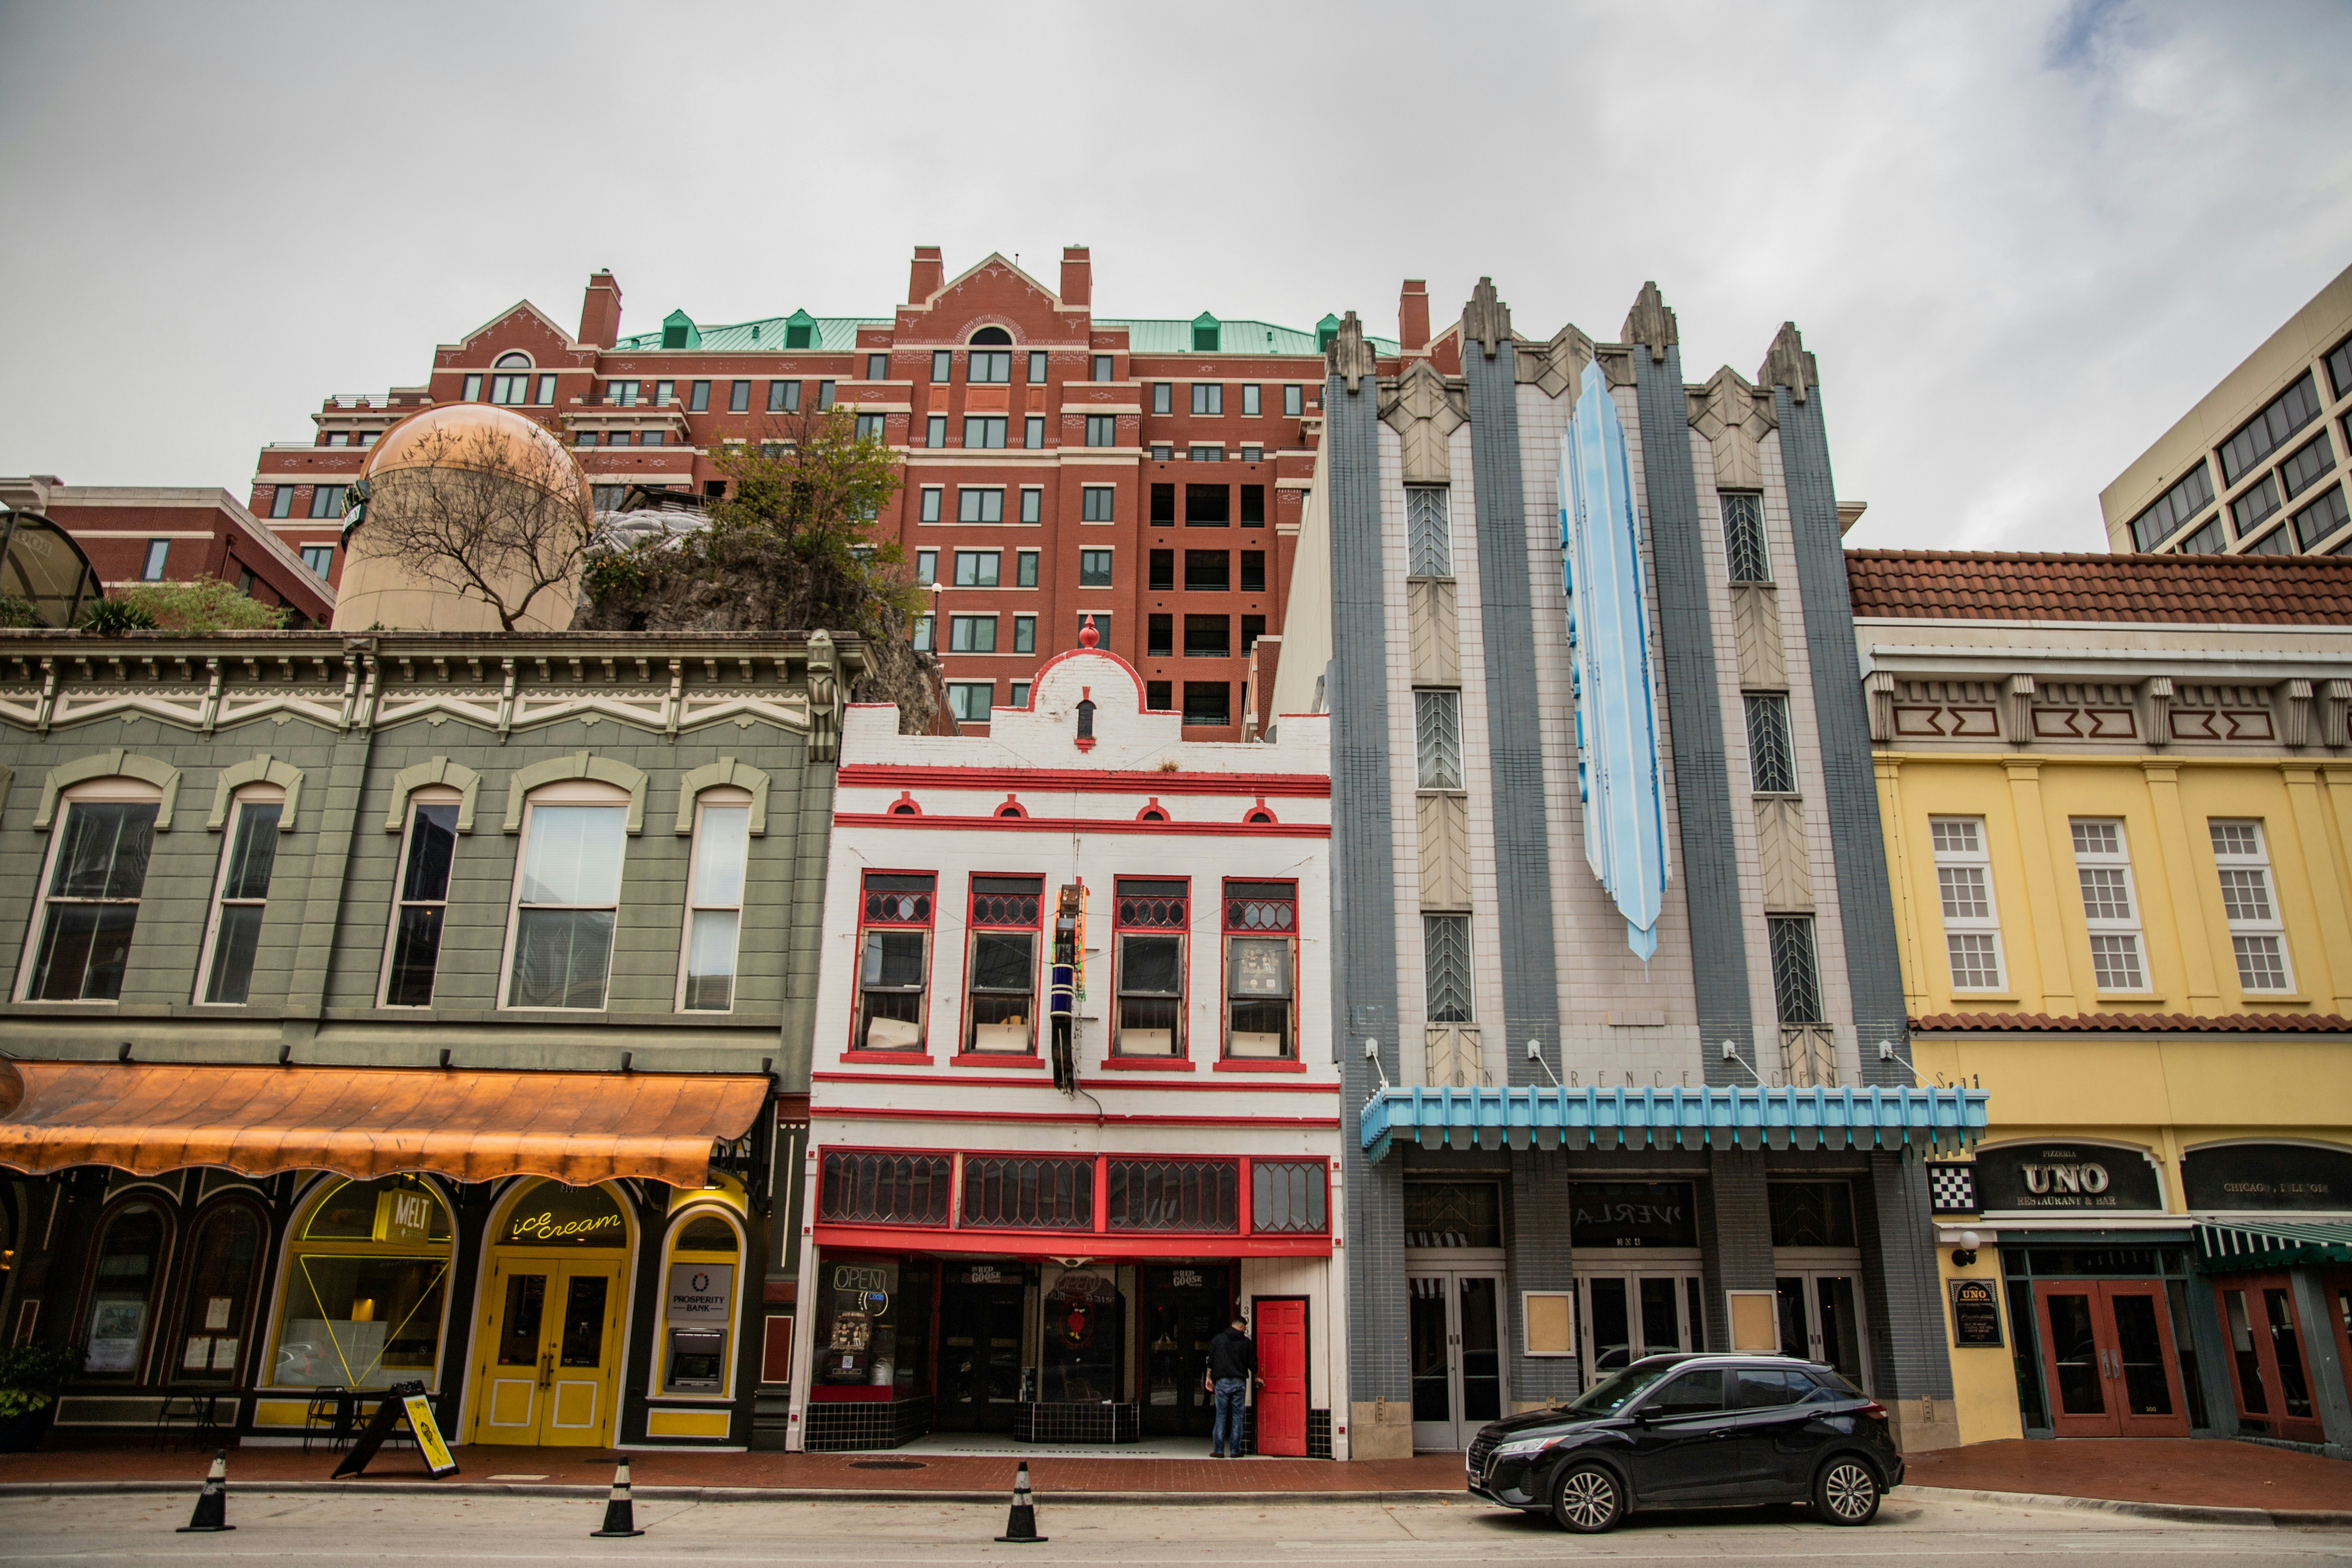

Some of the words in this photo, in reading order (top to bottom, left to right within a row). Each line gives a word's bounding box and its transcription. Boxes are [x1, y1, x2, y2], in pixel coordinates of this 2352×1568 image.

[1426, 1070, 1690, 1088] CONFERENCE
[2022, 1163, 2109, 1194] UNO
[2017, 1196, 2081, 1205] RESTAURANT
[2085, 1197, 2093, 1205] &
[2096, 1197, 2116, 1205] BAR
[395, 1193, 430, 1230] MELT
[513, 1212, 551, 1235] ice
[537, 1214, 621, 1239] cream
[1616, 1238, 1641, 1246] 304
[836, 1268, 881, 1289] OPEN
[972, 1271, 1001, 1283] GOOSE
[1173, 1276, 1202, 1287] GOOSE
[674, 1295, 725, 1303] PROSPERITY
[1961, 1290, 1987, 1298] UNO
